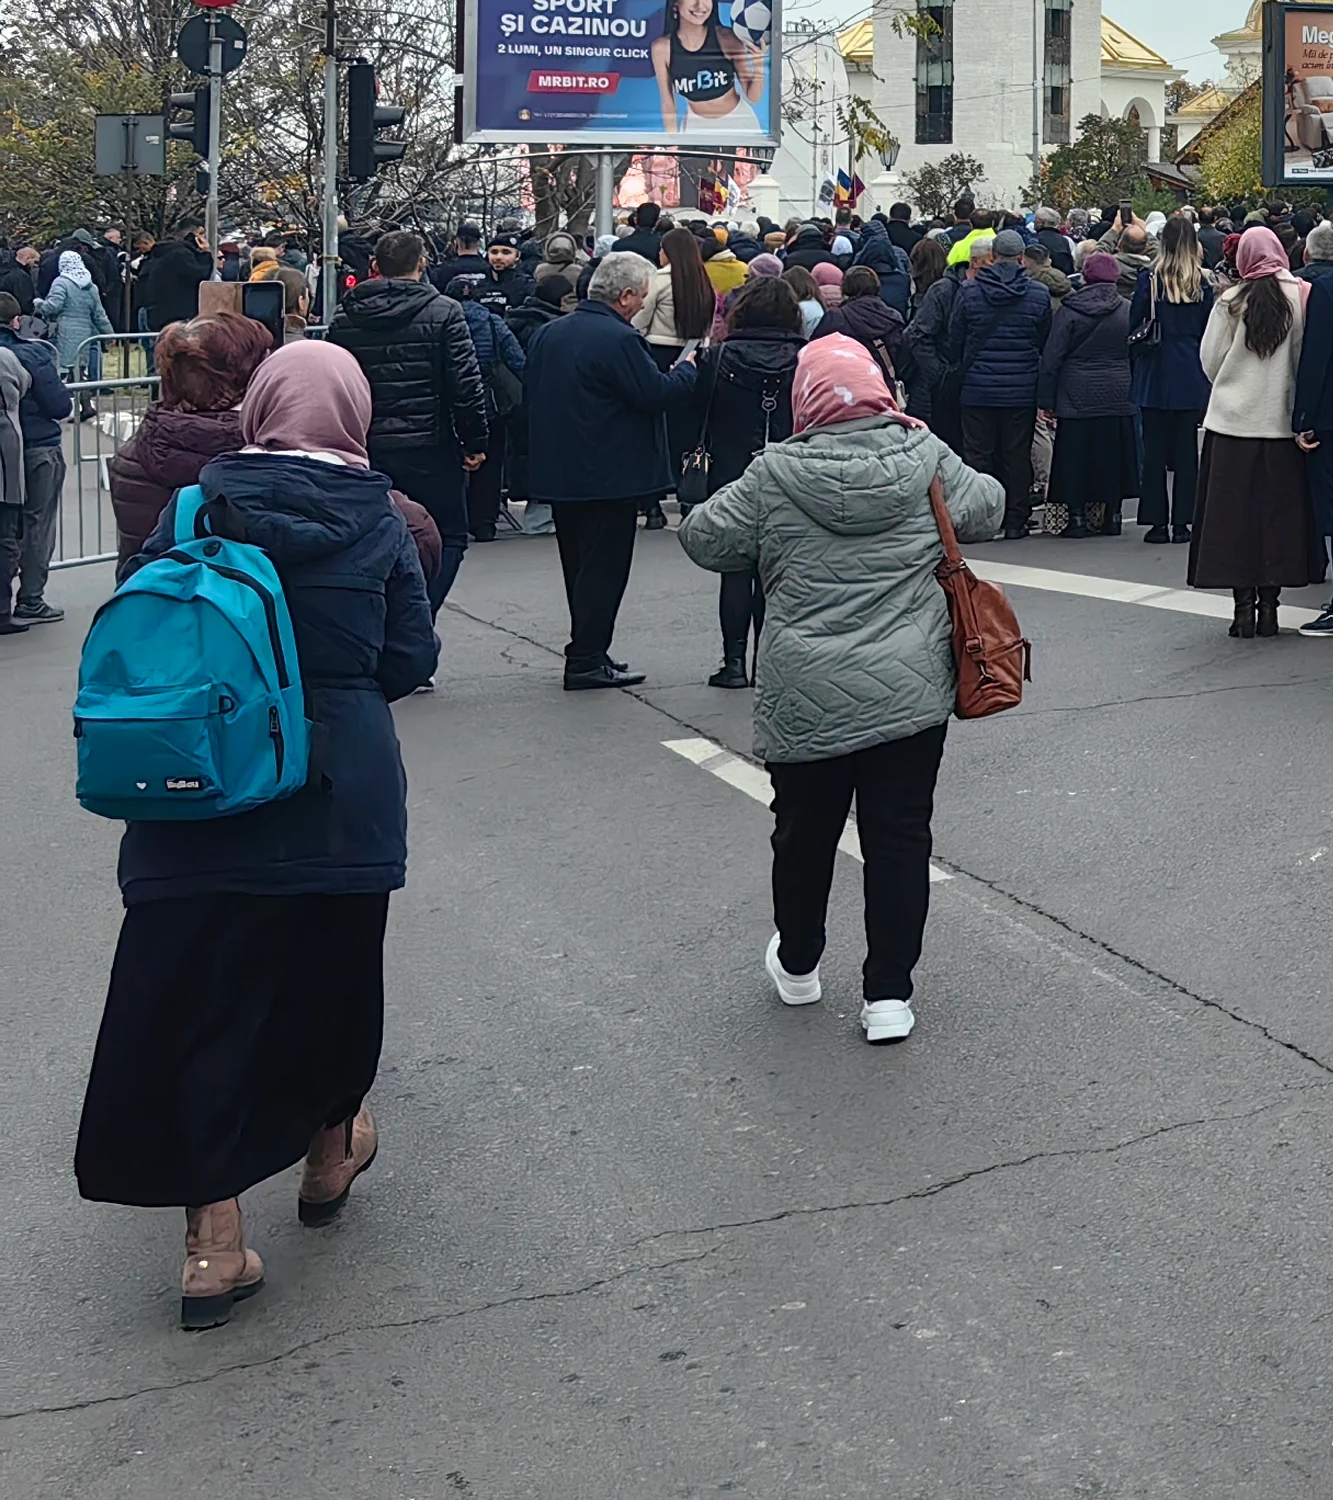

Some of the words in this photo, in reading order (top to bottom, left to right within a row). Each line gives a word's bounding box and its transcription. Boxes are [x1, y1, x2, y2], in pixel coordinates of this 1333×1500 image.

[530, 15, 647, 38] CAZINOU
[498, 44, 506, 53] 2
[508, 44, 541, 56] LUMI,
[544, 46, 562, 56] UN
[564, 46, 611, 57] SINGUR
[613, 48, 649, 58] CLICK
[538, 75, 610, 89] MRBIT.RO
[673, 70, 728, 93] MrBit
